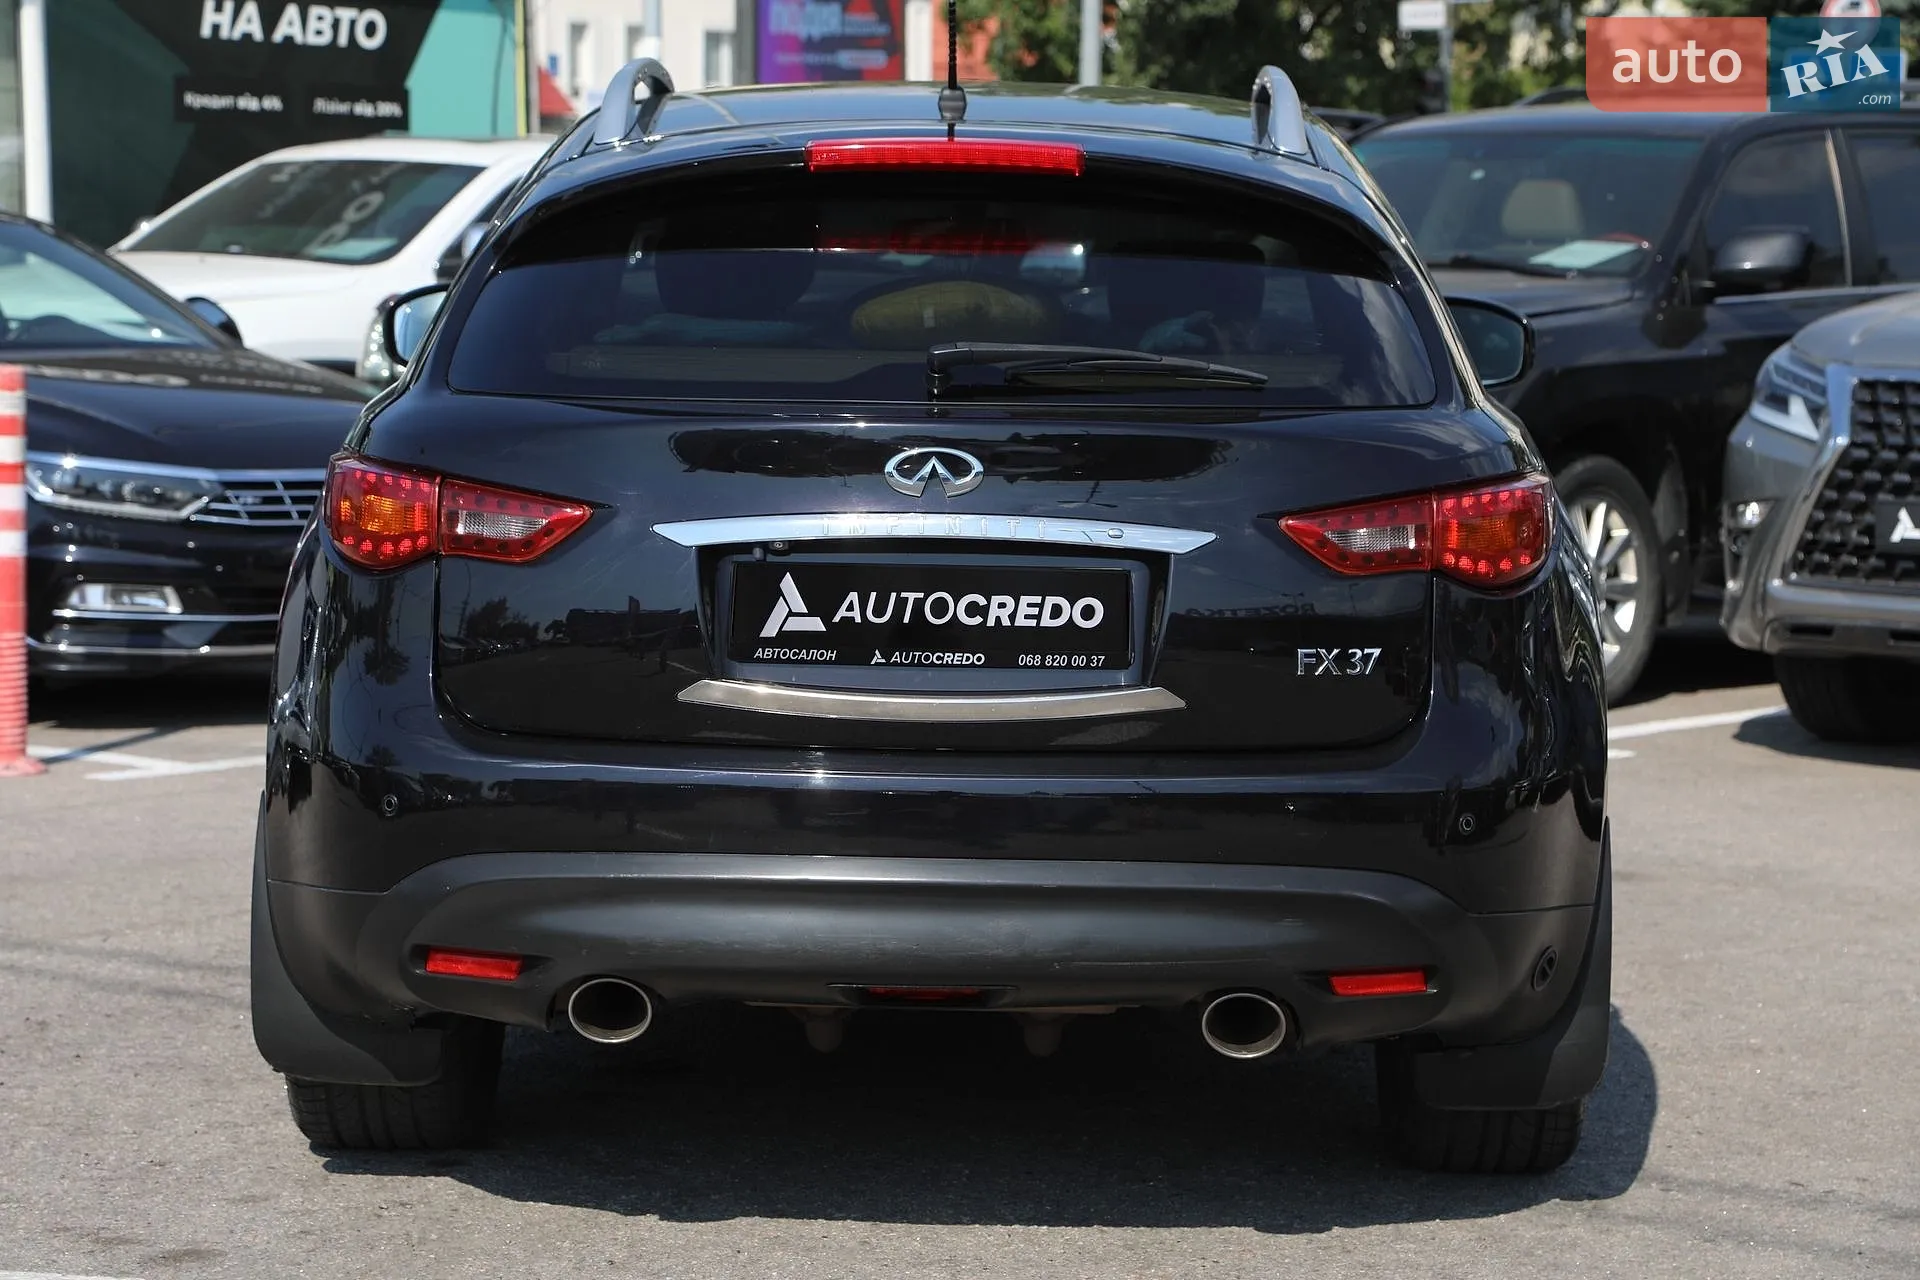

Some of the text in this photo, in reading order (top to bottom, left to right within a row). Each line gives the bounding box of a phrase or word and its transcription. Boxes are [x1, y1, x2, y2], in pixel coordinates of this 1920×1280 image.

[200, 0, 388, 50] НА АВТО
[822, 515, 1048, 539] INFINITI
[832, 591, 1104, 628] AUTOCREDO
[754, 648, 837, 661] АВТОСАЛОН
[890, 651, 985, 665] AUTOCREDO
[1018, 654, 1106, 667] 068 820 00 37
[1297, 648, 1382, 675] FX 37
